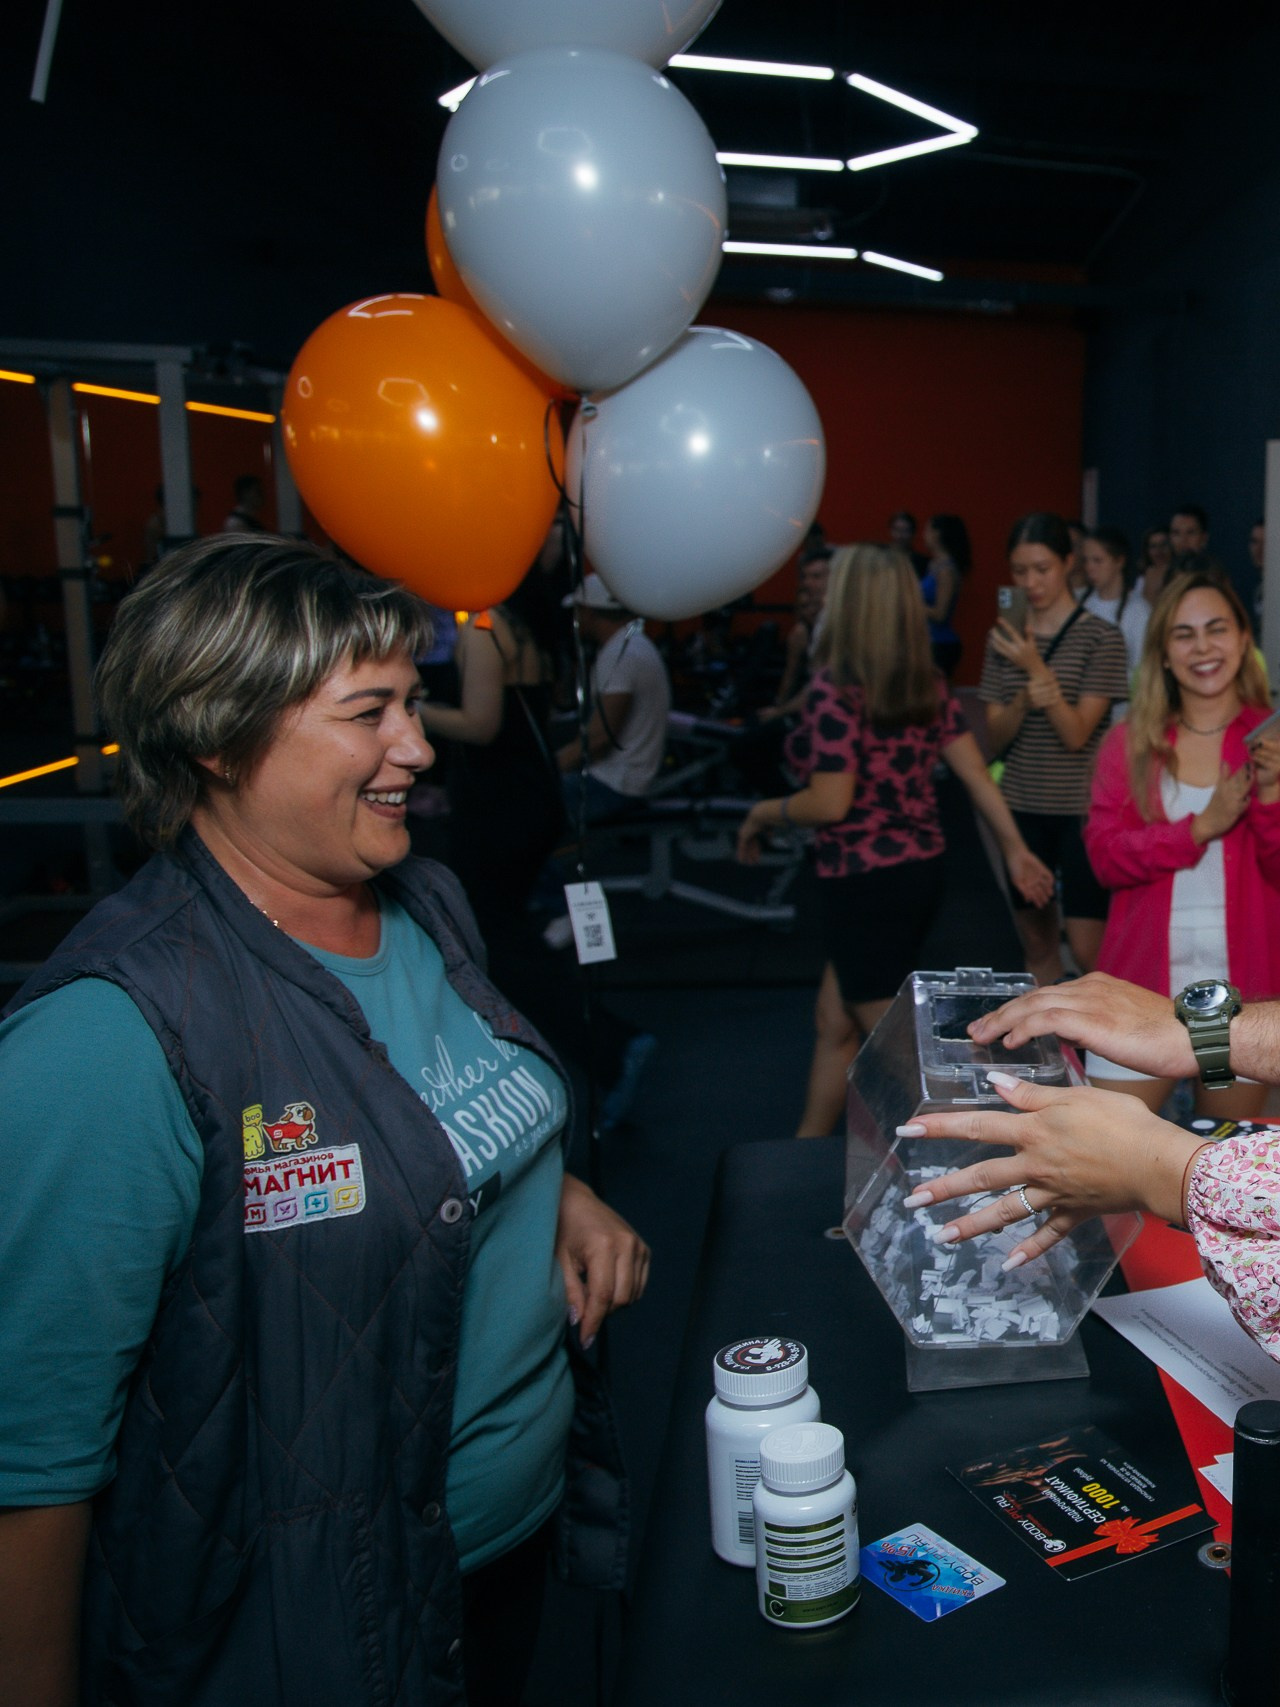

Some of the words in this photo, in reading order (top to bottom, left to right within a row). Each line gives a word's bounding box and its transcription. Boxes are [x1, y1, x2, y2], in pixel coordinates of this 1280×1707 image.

[439, 1065, 551, 1178] ASHION
[244, 1166, 271, 1175] емья
[274, 1152, 334, 1171] магазинов
[244, 1159, 355, 1197] МАГНИТ
[1041, 1488, 1084, 1523] ПОДАРОЧНЫЙ
[1044, 1475, 1106, 1524] СЕРТИФИКАТ
[1082, 1482, 1121, 1509] 1000
[993, 1495, 1047, 1541] BODY-PIT.RU
[881, 1542, 917, 1558] 15%
[906, 1533, 984, 1587] BODY-PIT.RU
